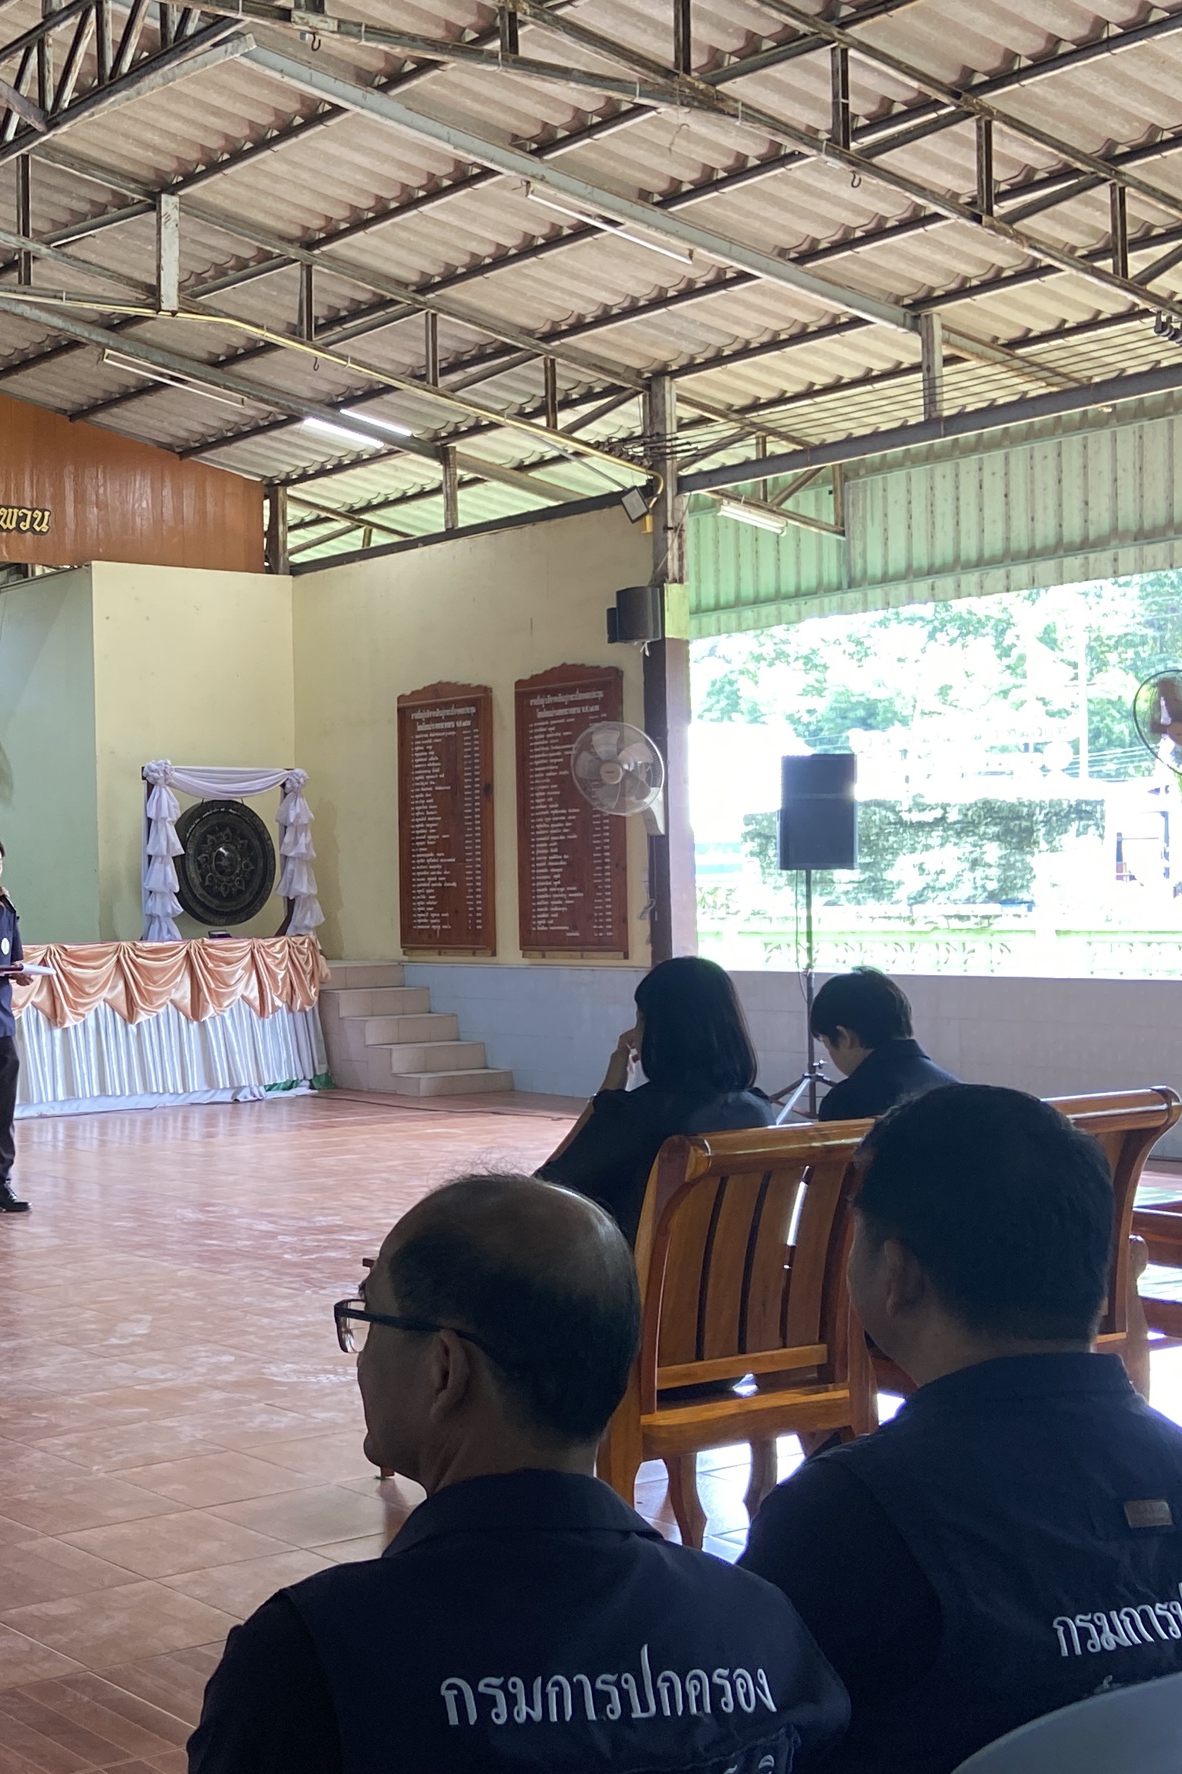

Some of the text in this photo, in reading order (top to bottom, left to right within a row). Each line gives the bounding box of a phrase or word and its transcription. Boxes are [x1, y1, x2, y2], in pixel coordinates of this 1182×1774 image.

[440, 1643, 777, 1726] กรมการปกครอง
